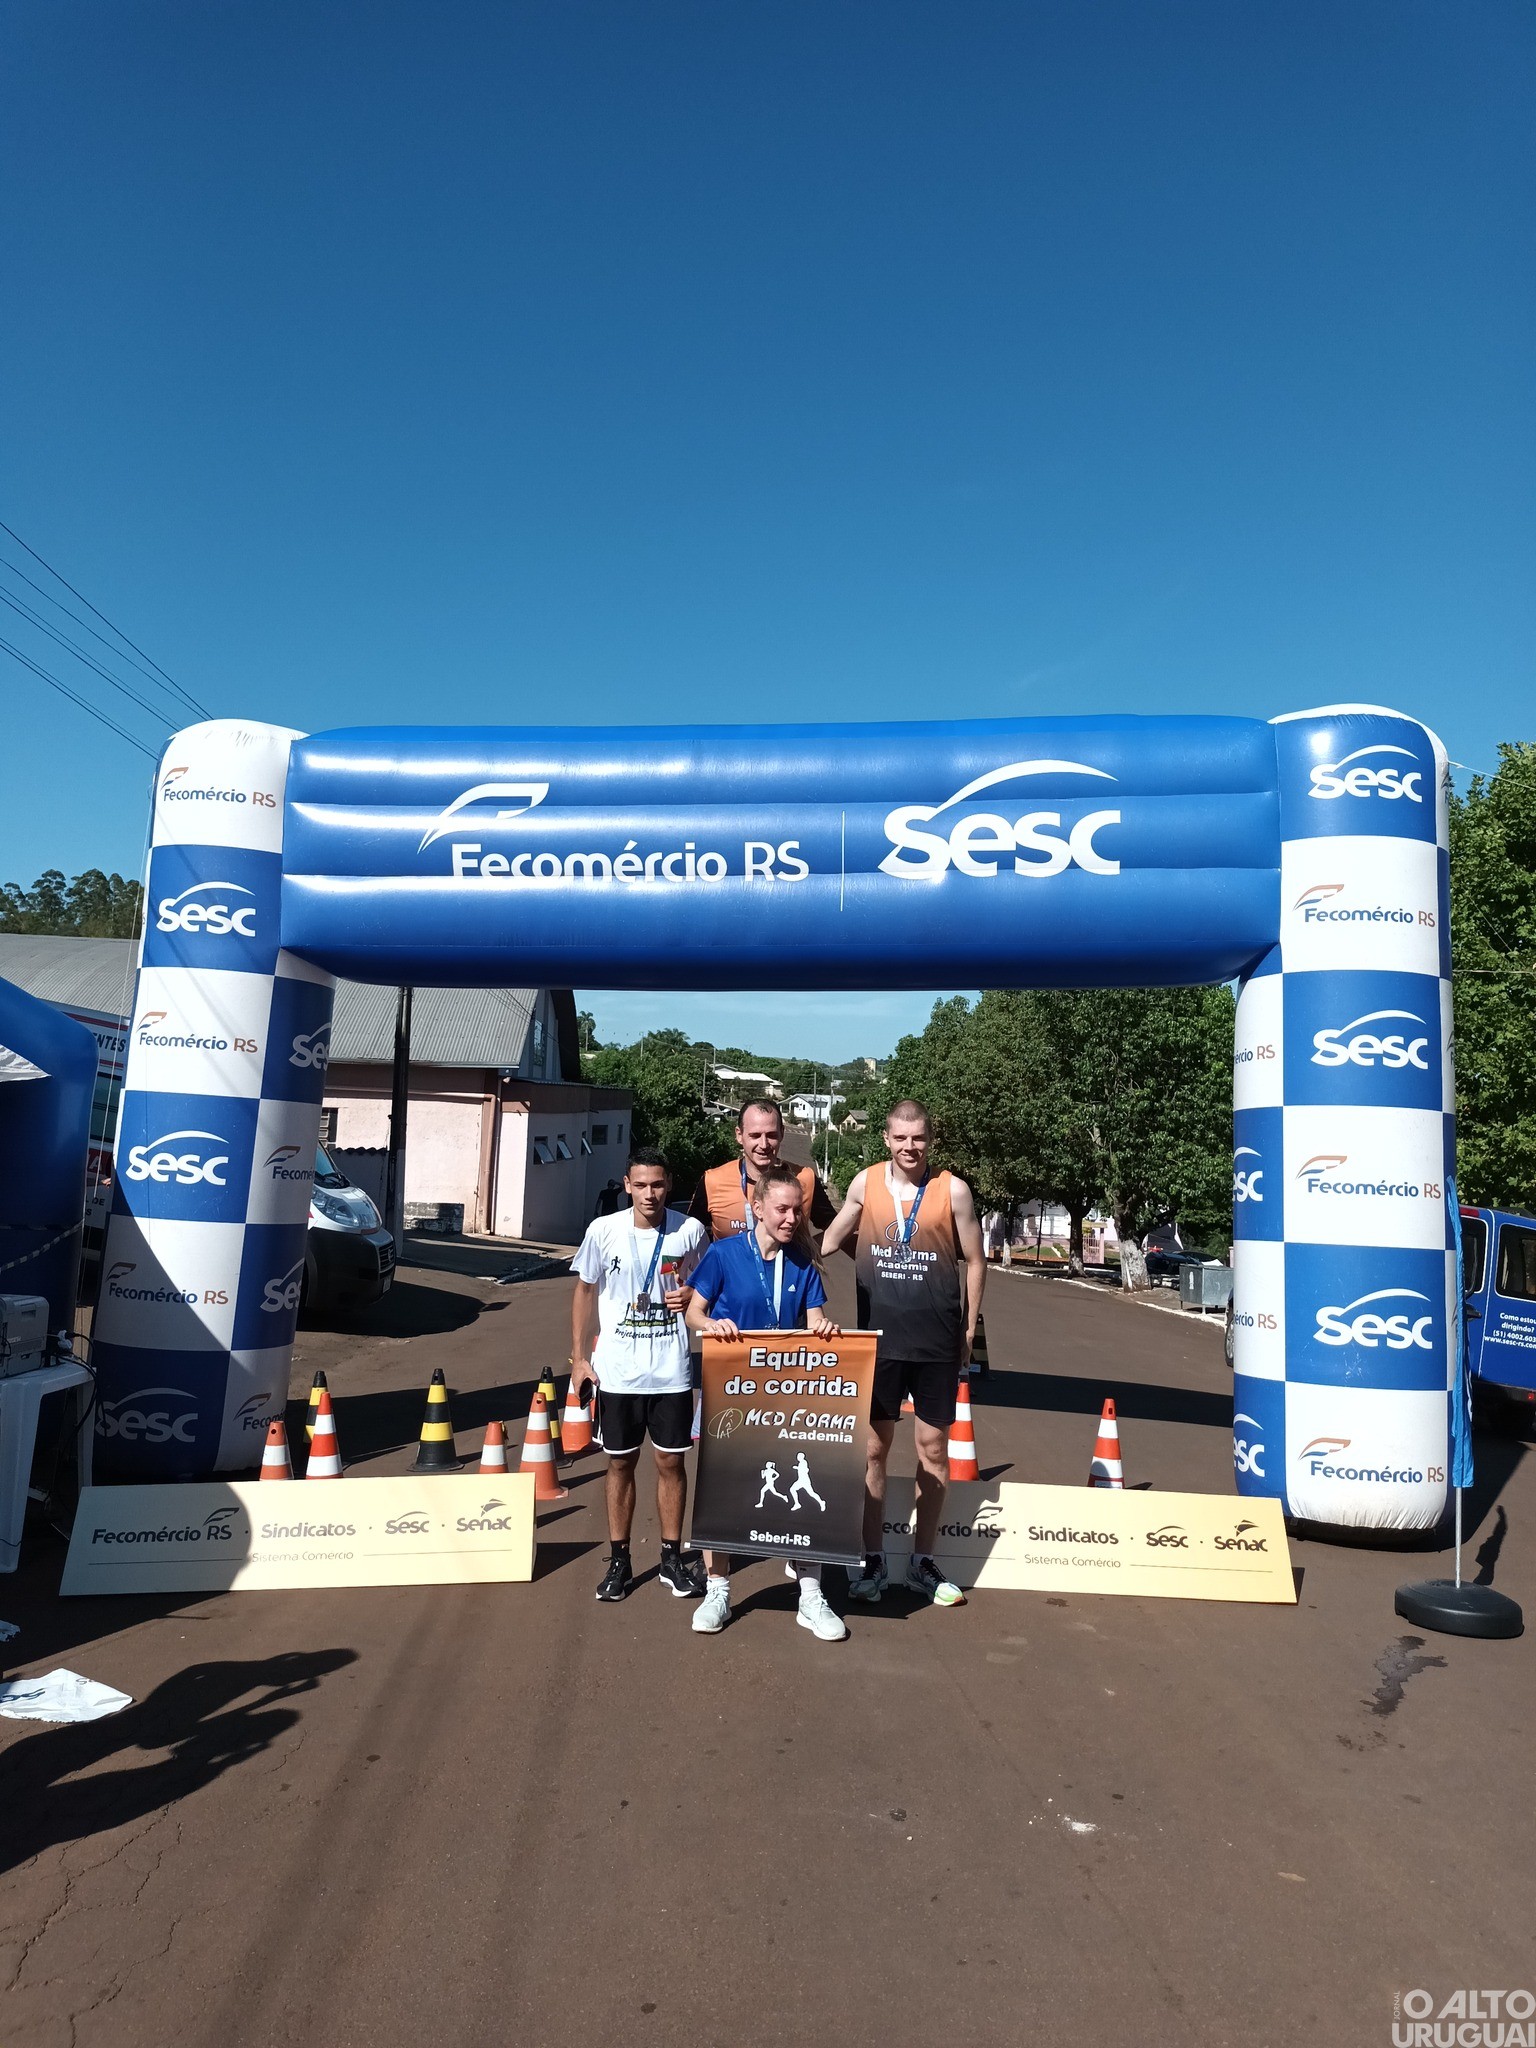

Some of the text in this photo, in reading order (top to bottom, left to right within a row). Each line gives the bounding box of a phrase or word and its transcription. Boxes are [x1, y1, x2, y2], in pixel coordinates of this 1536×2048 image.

[1308, 763, 1423, 803] Sesc
[163, 786, 277, 808] Fecomércio RS
[877, 804, 1122, 880] Sesc
[452, 839, 810, 883] Fecomércio RS
[156, 897, 257, 937] Sesc
[1304, 906, 1436, 928] Fecomércio RS
[93, 1032, 126, 1053] NTES
[139, 1032, 259, 1054] Fecomércio RS
[1257, 1044, 1275, 1060] RS
[1310, 1028, 1429, 1070] Sesc
[126, 1145, 229, 1186] Sesc
[1307, 1178, 1442, 1200] Fecomércio RS
[730, 1220, 747, 1229] Me
[871, 1244, 892, 1258] Med
[876, 1259, 929, 1272] Academia
[108, 1282, 229, 1306] Fecomércio RS
[1258, 1313, 1277, 1330] RS
[1313, 1305, 1433, 1350] Sesc
[1500, 1312, 1519, 1322] Como
[1501, 1322, 1535, 1333] dirigindo?
[750, 1346, 839, 1372] Equipe
[724, 1375, 859, 1398] de corrida
[95, 1401, 199, 1443] Sesc
[777, 1428, 853, 1444] Academia
[1310, 1460, 1445, 1484] Fecomércio RS
[91, 1516, 512, 1544] Fecomércio RS Sindicatos Sesc Senac
[749, 1529, 811, 1547] Seberi-RS
[977, 1523, 1001, 1539] RS
[1028, 1526, 1119, 1545] Sindicatos
[1146, 1532, 1189, 1548] Sesc
[1214, 1535, 1269, 1553] Senac
[252, 1552, 299, 1563] Sistema
[1024, 1554, 1121, 1568] Sistema Comércio
